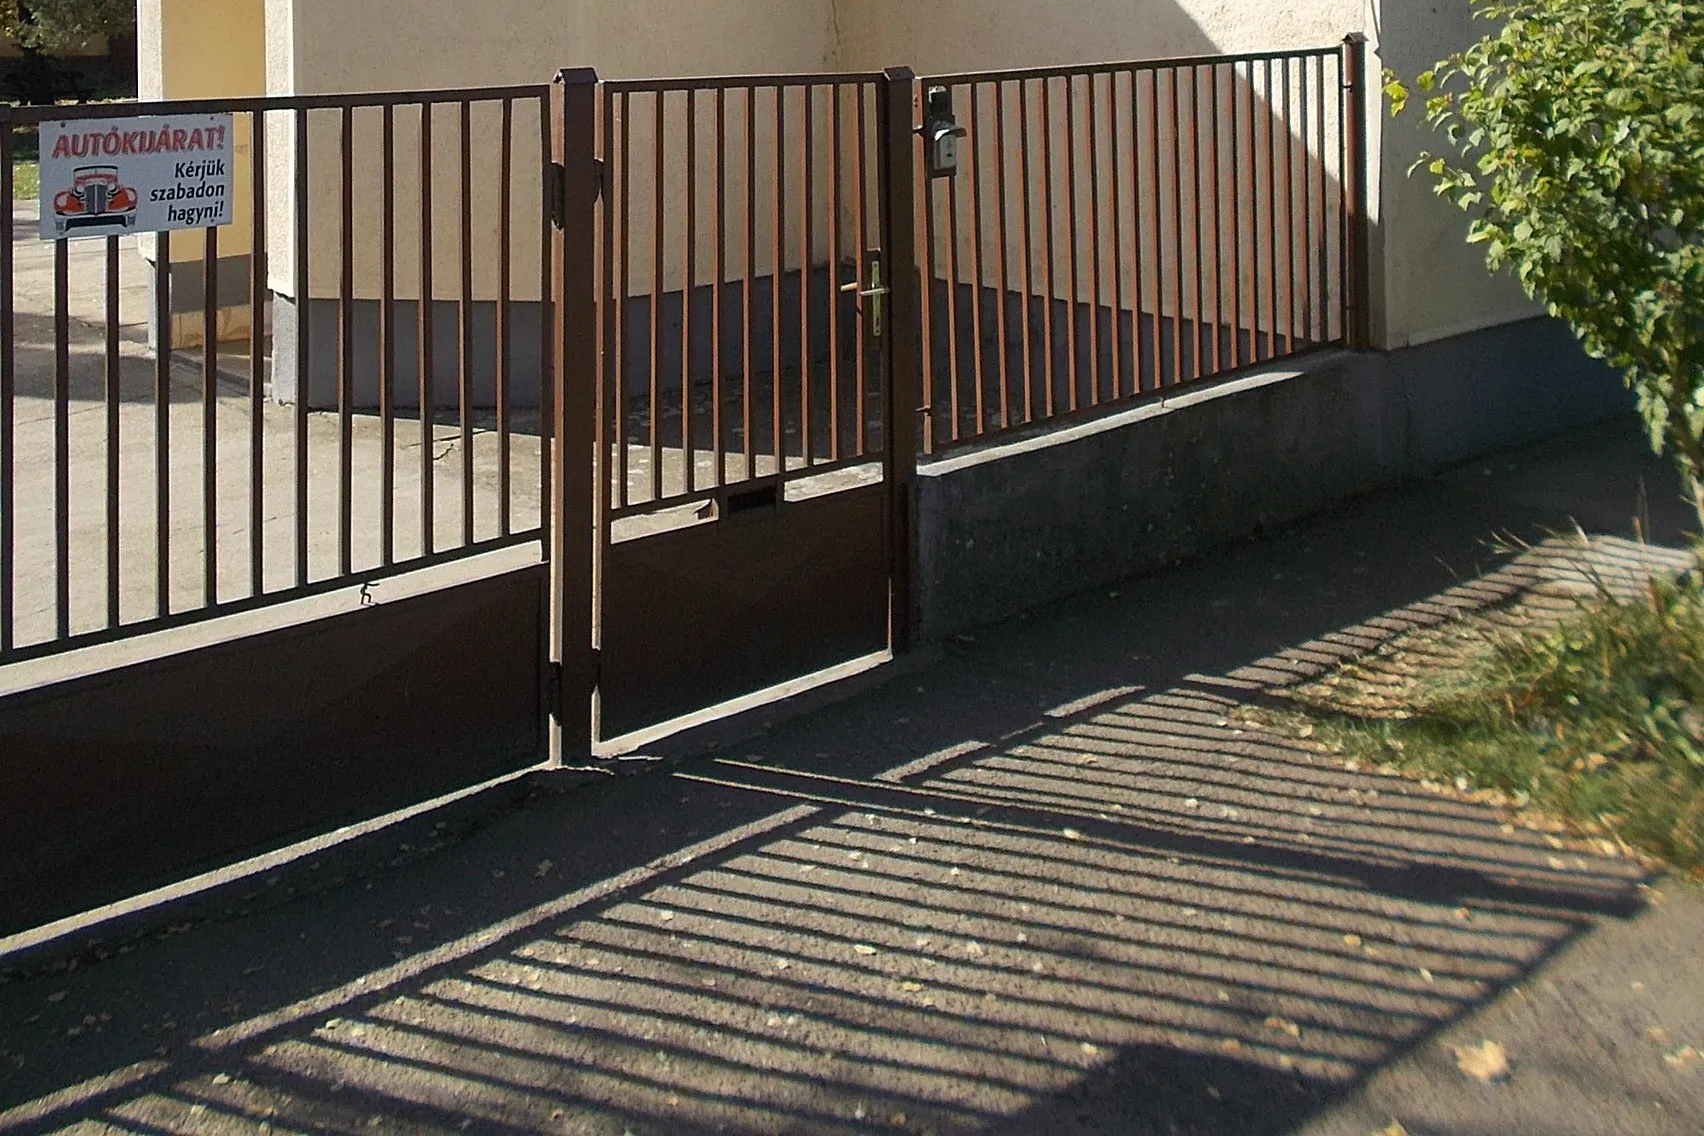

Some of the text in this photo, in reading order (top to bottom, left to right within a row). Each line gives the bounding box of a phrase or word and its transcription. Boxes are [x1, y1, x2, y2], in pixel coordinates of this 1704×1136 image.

[53, 125, 225, 157] AUTÓKIJÁRAT!
[175, 159, 225, 181] Kérjük
[150, 180, 225, 202] szabadon
[168, 201, 224, 224] hagyni!
